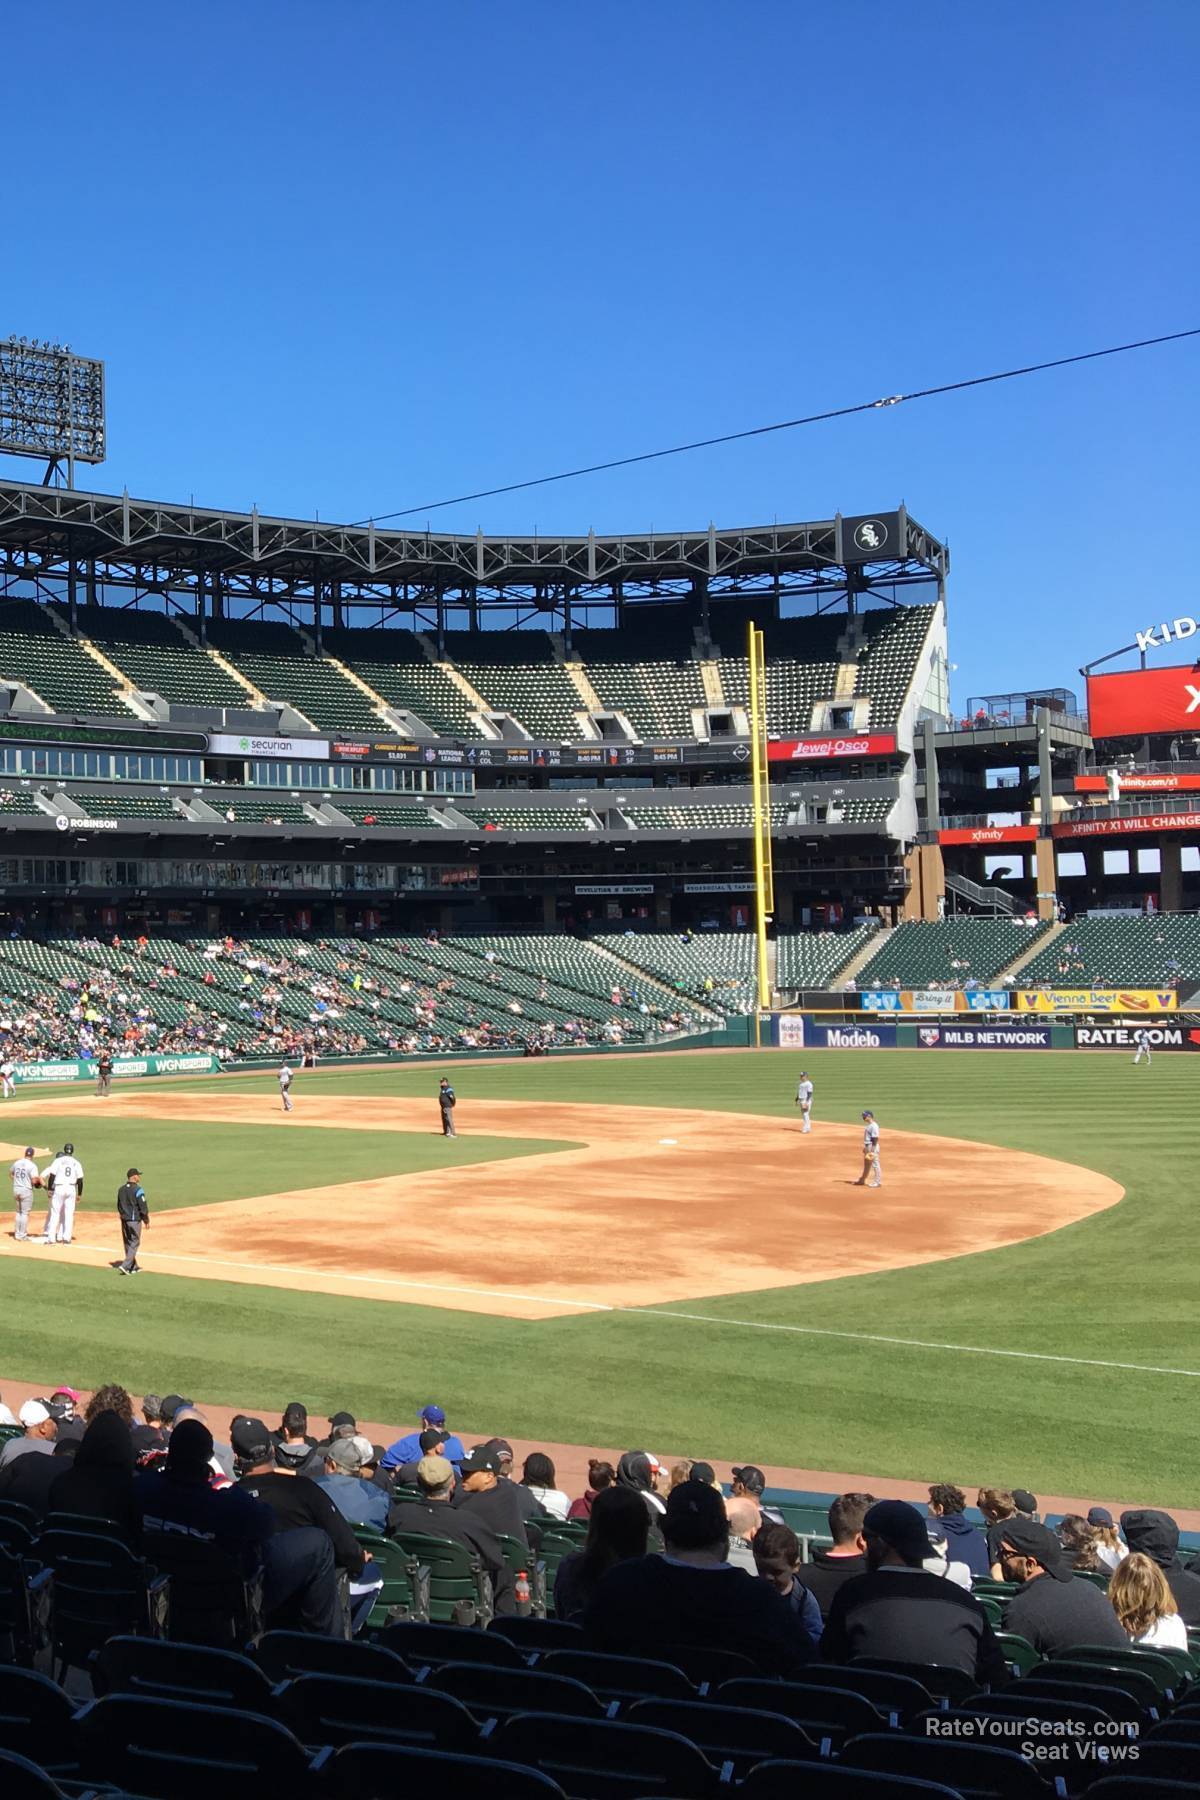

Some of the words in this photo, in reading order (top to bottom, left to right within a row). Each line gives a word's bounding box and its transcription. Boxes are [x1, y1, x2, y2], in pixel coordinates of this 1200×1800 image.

[252, 740, 292, 750] securian
[794, 740, 869, 755] Jewel-Osco
[58, 818, 68, 827] 42
[71, 818, 117, 829] ROBINSON
[1072, 822, 1107, 833] XFINITY
[1110, 821, 1121, 830] X1
[1124, 819, 1150, 829] WILL
[1152, 815, 1200, 827] CHANGE
[972, 830, 1004, 841] xfinity
[915, 992, 944, 1004] Bring
[1044, 992, 1086, 1003] Vienna
[1090, 992, 1117, 1003] Beef
[827, 1029, 880, 1047] Modelo
[945, 1032, 974, 1043] MLB
[977, 1033, 1046, 1044] NETWORK
[15, 1168, 26, 1179] 26
[64, 1166, 72, 1177] 8
